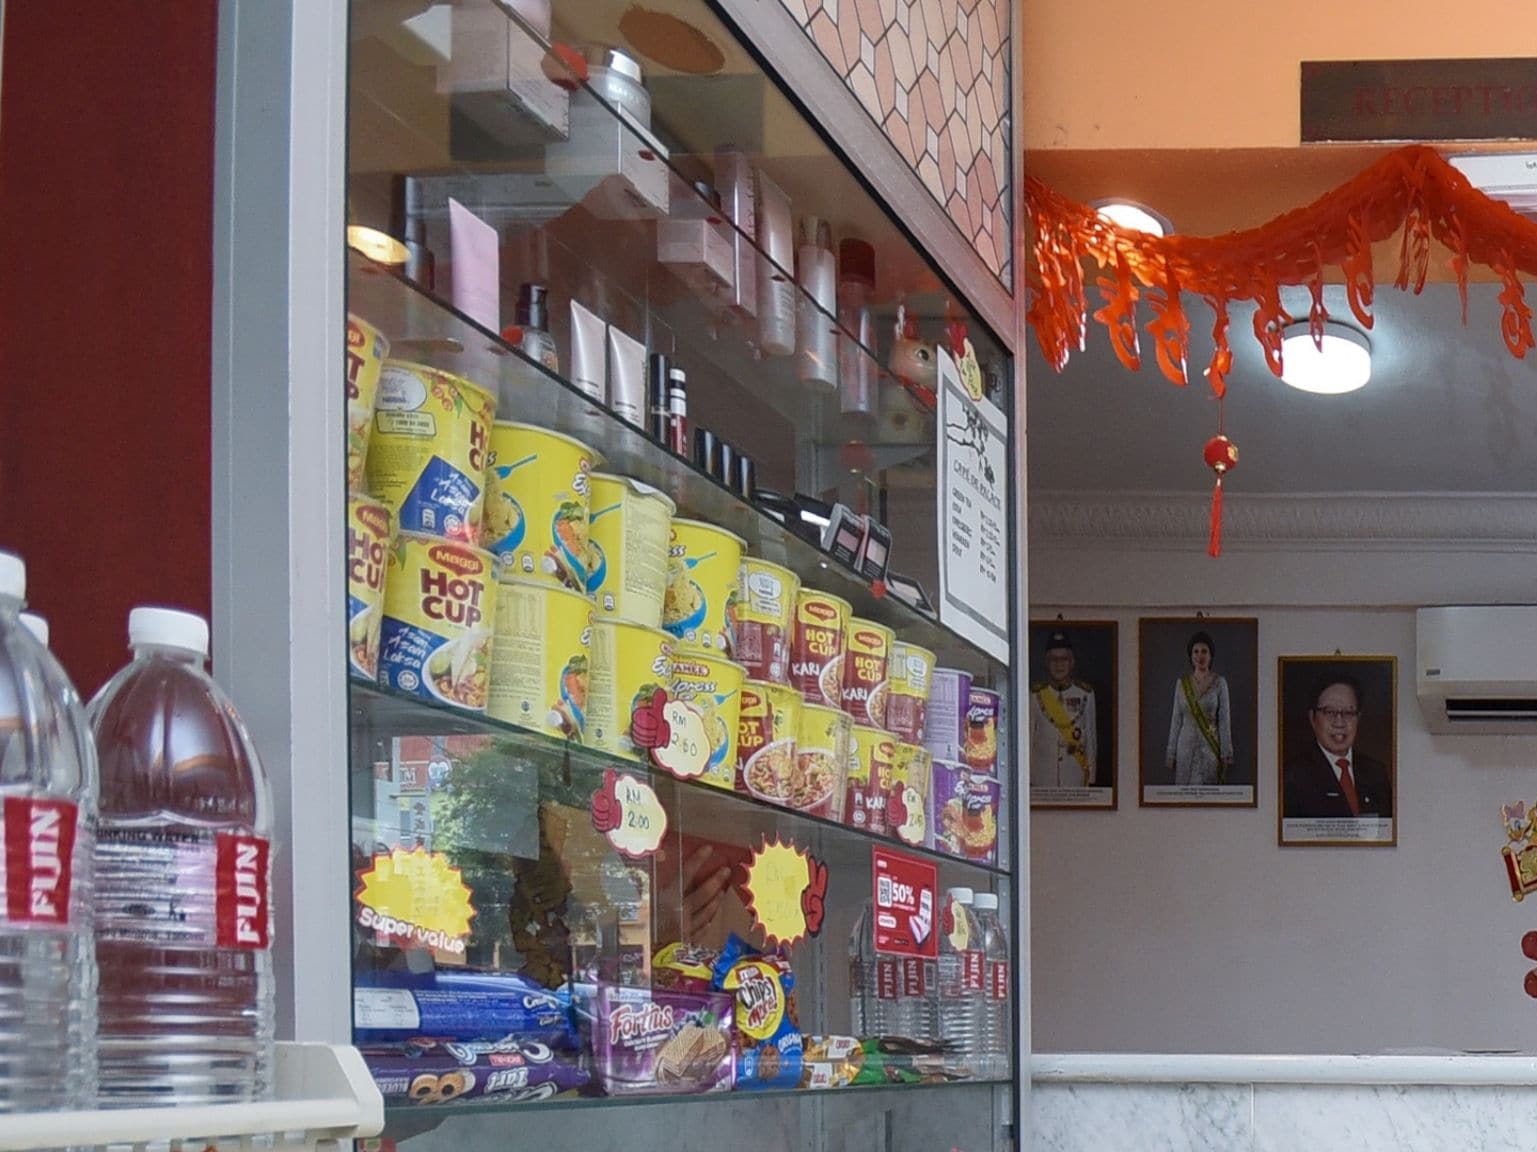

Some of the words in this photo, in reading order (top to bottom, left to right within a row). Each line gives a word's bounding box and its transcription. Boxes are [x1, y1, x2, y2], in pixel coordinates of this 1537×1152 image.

[350, 528, 384, 566] HO
[350, 558, 384, 592] CU
[421, 568, 484, 606] HOT
[421, 595, 481, 627] CUP
[805, 629, 834, 643] HOT
[808, 642, 836, 657] CUP
[792, 662, 820, 677] KARI
[855, 657, 881, 670] HOT
[858, 669, 881, 682] CUP
[842, 687, 868, 700] KARI
[741, 736, 763, 748] UP
[235, 843, 261, 944] FIJIN
[893, 882, 915, 905] 50%
[359, 906, 414, 939] Super
[414, 926, 465, 954] value
[736, 980, 772, 1010] Chips
